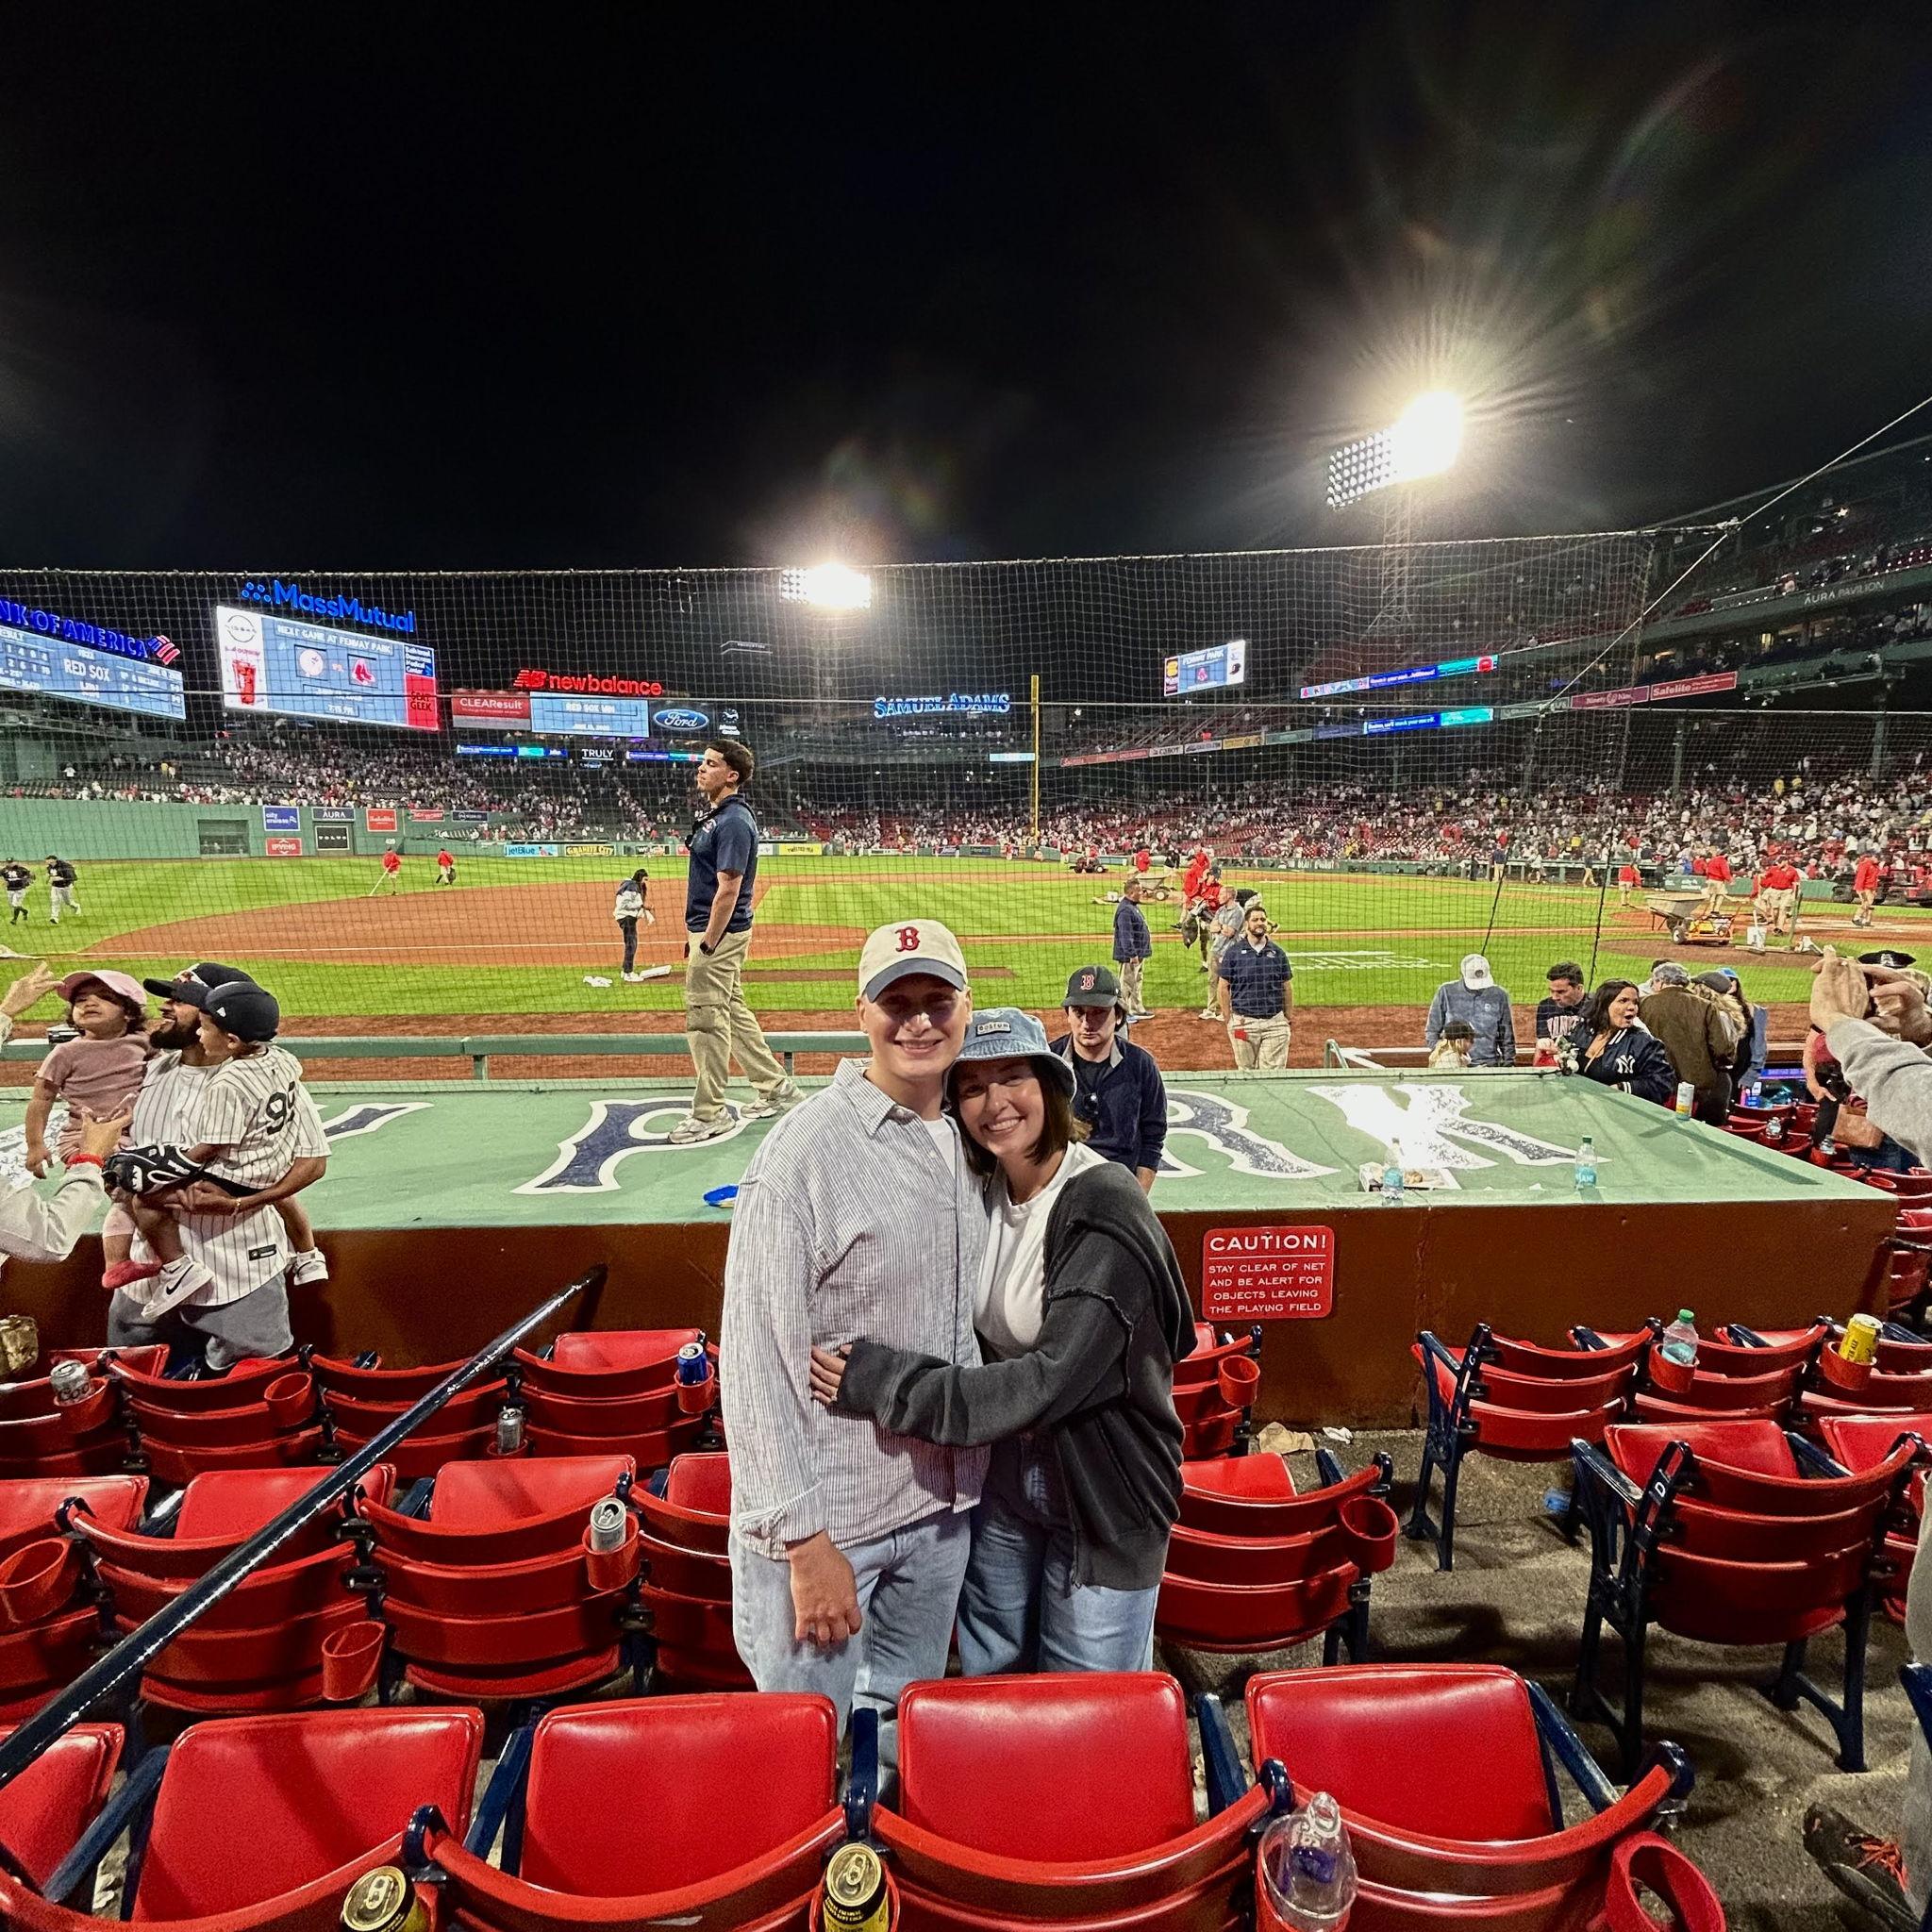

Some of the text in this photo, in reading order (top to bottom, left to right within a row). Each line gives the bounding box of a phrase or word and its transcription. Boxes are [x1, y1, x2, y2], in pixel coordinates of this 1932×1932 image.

[1838, 580, 1885, 598] PAVILION
[274, 579, 414, 632] MassMutual
[33, 609, 59, 634] OF
[64, 619, 148, 658] AMERICA
[64, 658, 110, 682] RED SOX
[1653, 685, 1691, 696] Safelite
[410, 701, 432, 712] GEEK
[459, 698, 523, 709] CLEAResult
[566, 703, 582, 713] RED
[584, 704, 600, 714] SOX
[874, 692, 1010, 719] SAMUEL ADAMS
[664, 712, 698, 727] Ford
[582, 749, 613, 758] TRULY
[508, 845, 536, 856] jetBlue
[598, 845, 613, 856] CITY
[895, 926, 921, 952] B
[1080, 974, 1095, 991] B
[1615, 1055, 1636, 1074] NY
[1209, 1234, 1326, 1252] CAUTION!
[1208, 1262, 1325, 1274] STAY CLEAR OF NET
[1209, 1278, 1232, 1287] AND
[1257, 1276, 1293, 1286] ALERT
[1213, 1290, 1318, 1301] OBJECTS LEAVING
[1209, 1303, 1322, 1314] THE PLAYING FIELD
[1655, 1481, 1666, 1498] D
